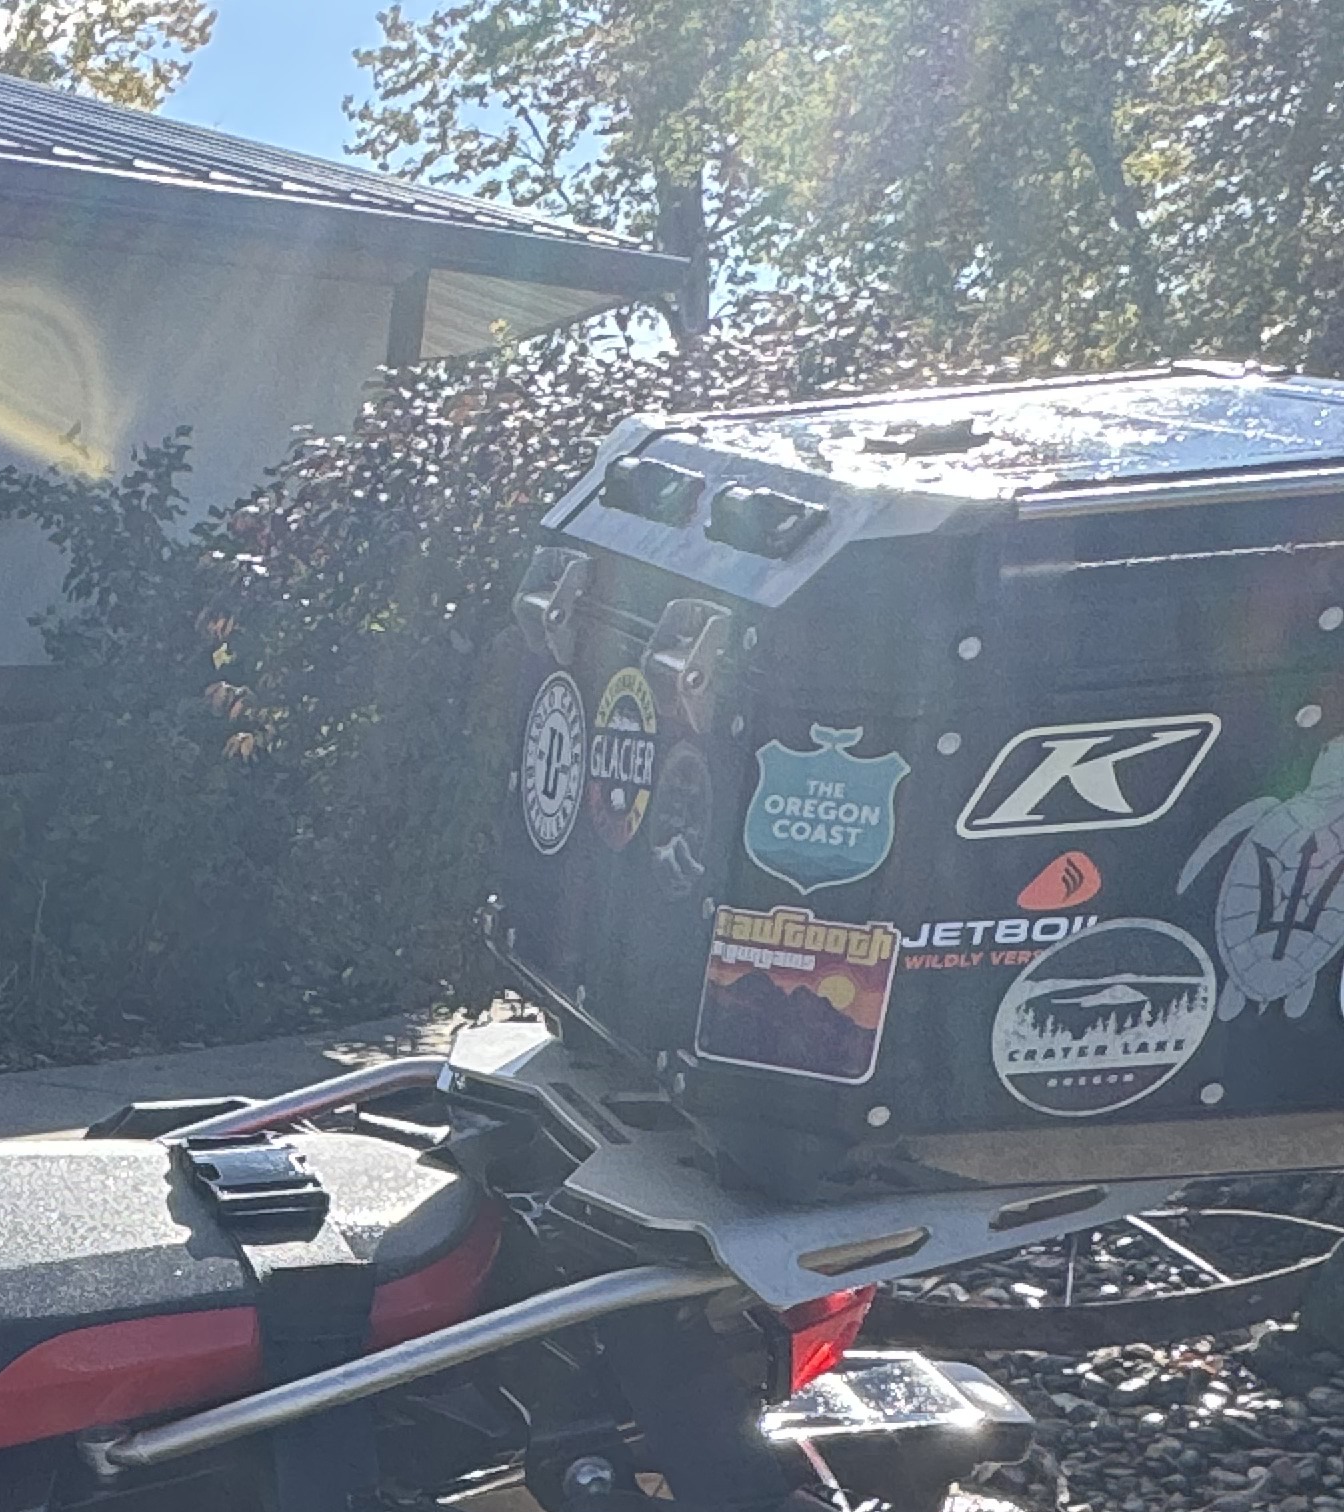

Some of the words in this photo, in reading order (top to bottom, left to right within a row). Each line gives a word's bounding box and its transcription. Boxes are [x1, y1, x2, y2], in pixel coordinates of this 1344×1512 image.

[590, 734, 655, 786] GLACIER
[807, 780, 845, 799] THE
[764, 794, 880, 826] OREGON
[772, 818, 863, 847] COAST
[904, 952, 983, 970] WILDLY
